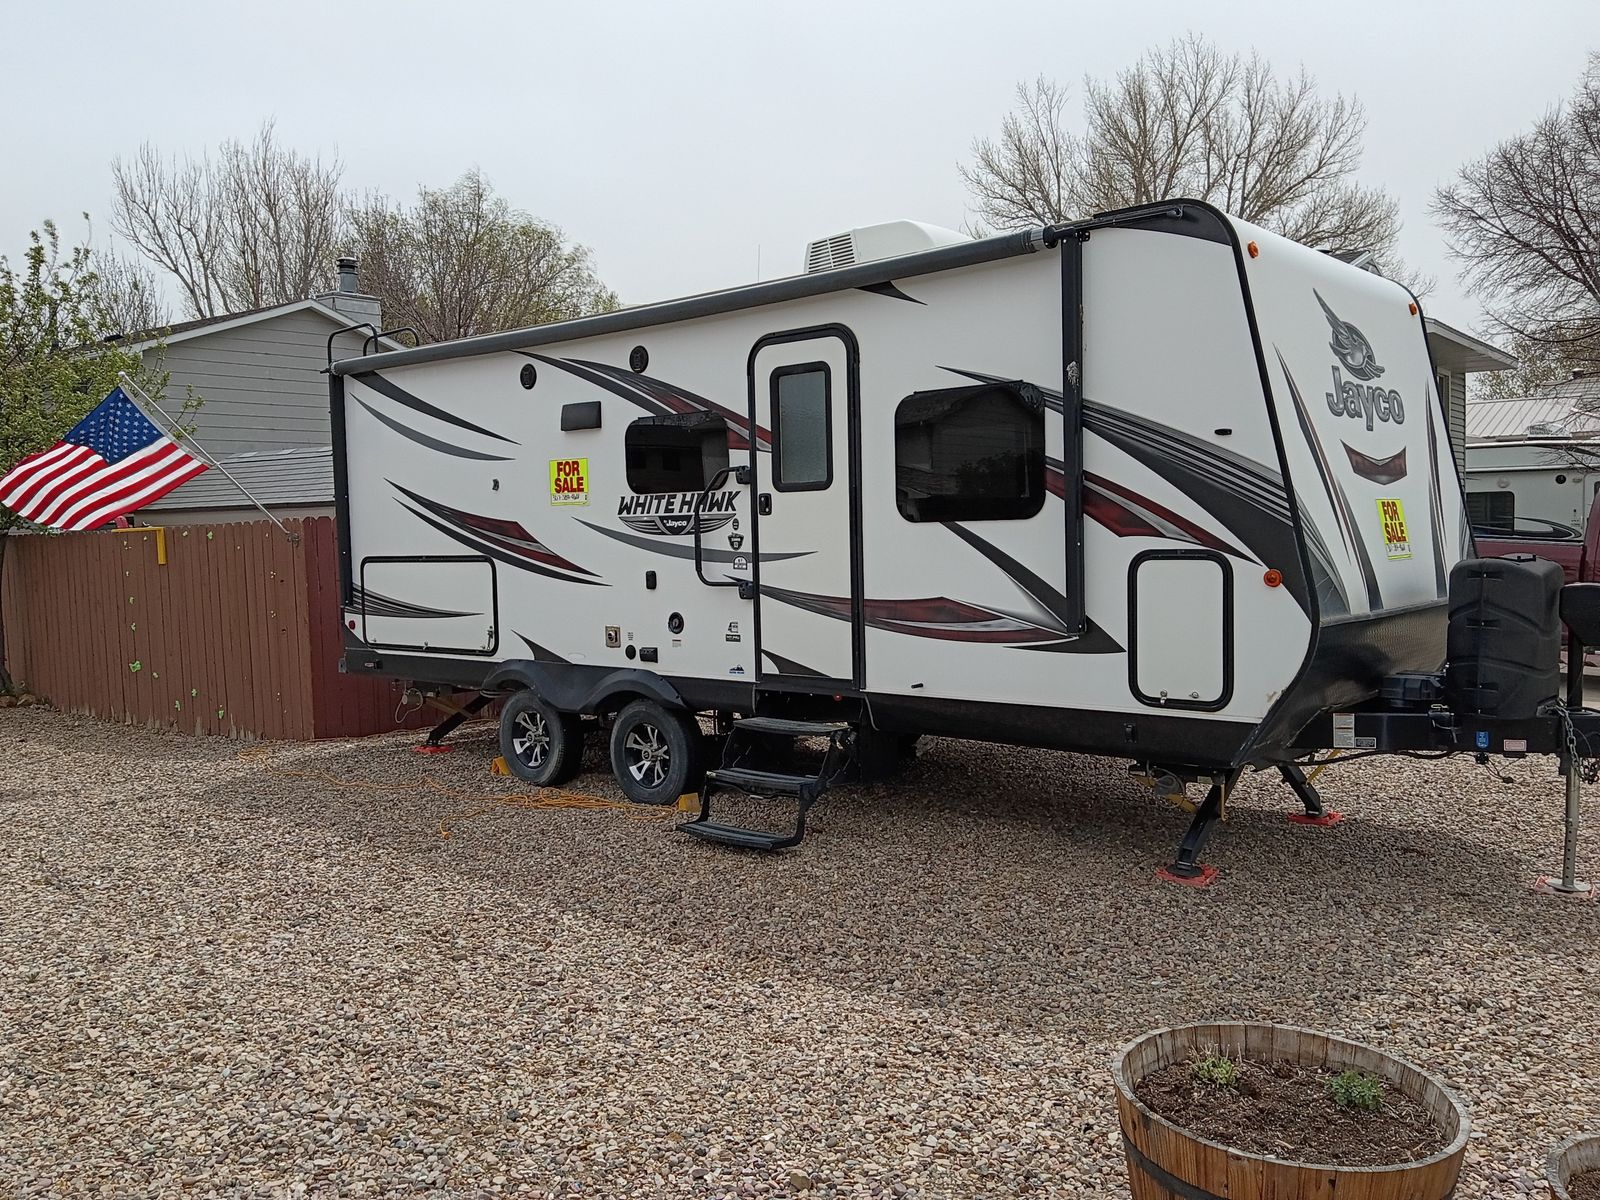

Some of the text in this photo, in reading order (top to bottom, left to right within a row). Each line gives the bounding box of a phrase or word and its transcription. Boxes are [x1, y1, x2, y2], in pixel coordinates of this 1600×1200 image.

[1326, 365, 1404, 431] Jayco
[557, 461, 580, 477] FOR
[555, 477, 584, 493] SALE
[618, 494, 677, 515] WHITE
[1381, 501, 1400, 521] FOR
[666, 520, 687, 528] Jayco
[1384, 522, 1407, 543] SALE
